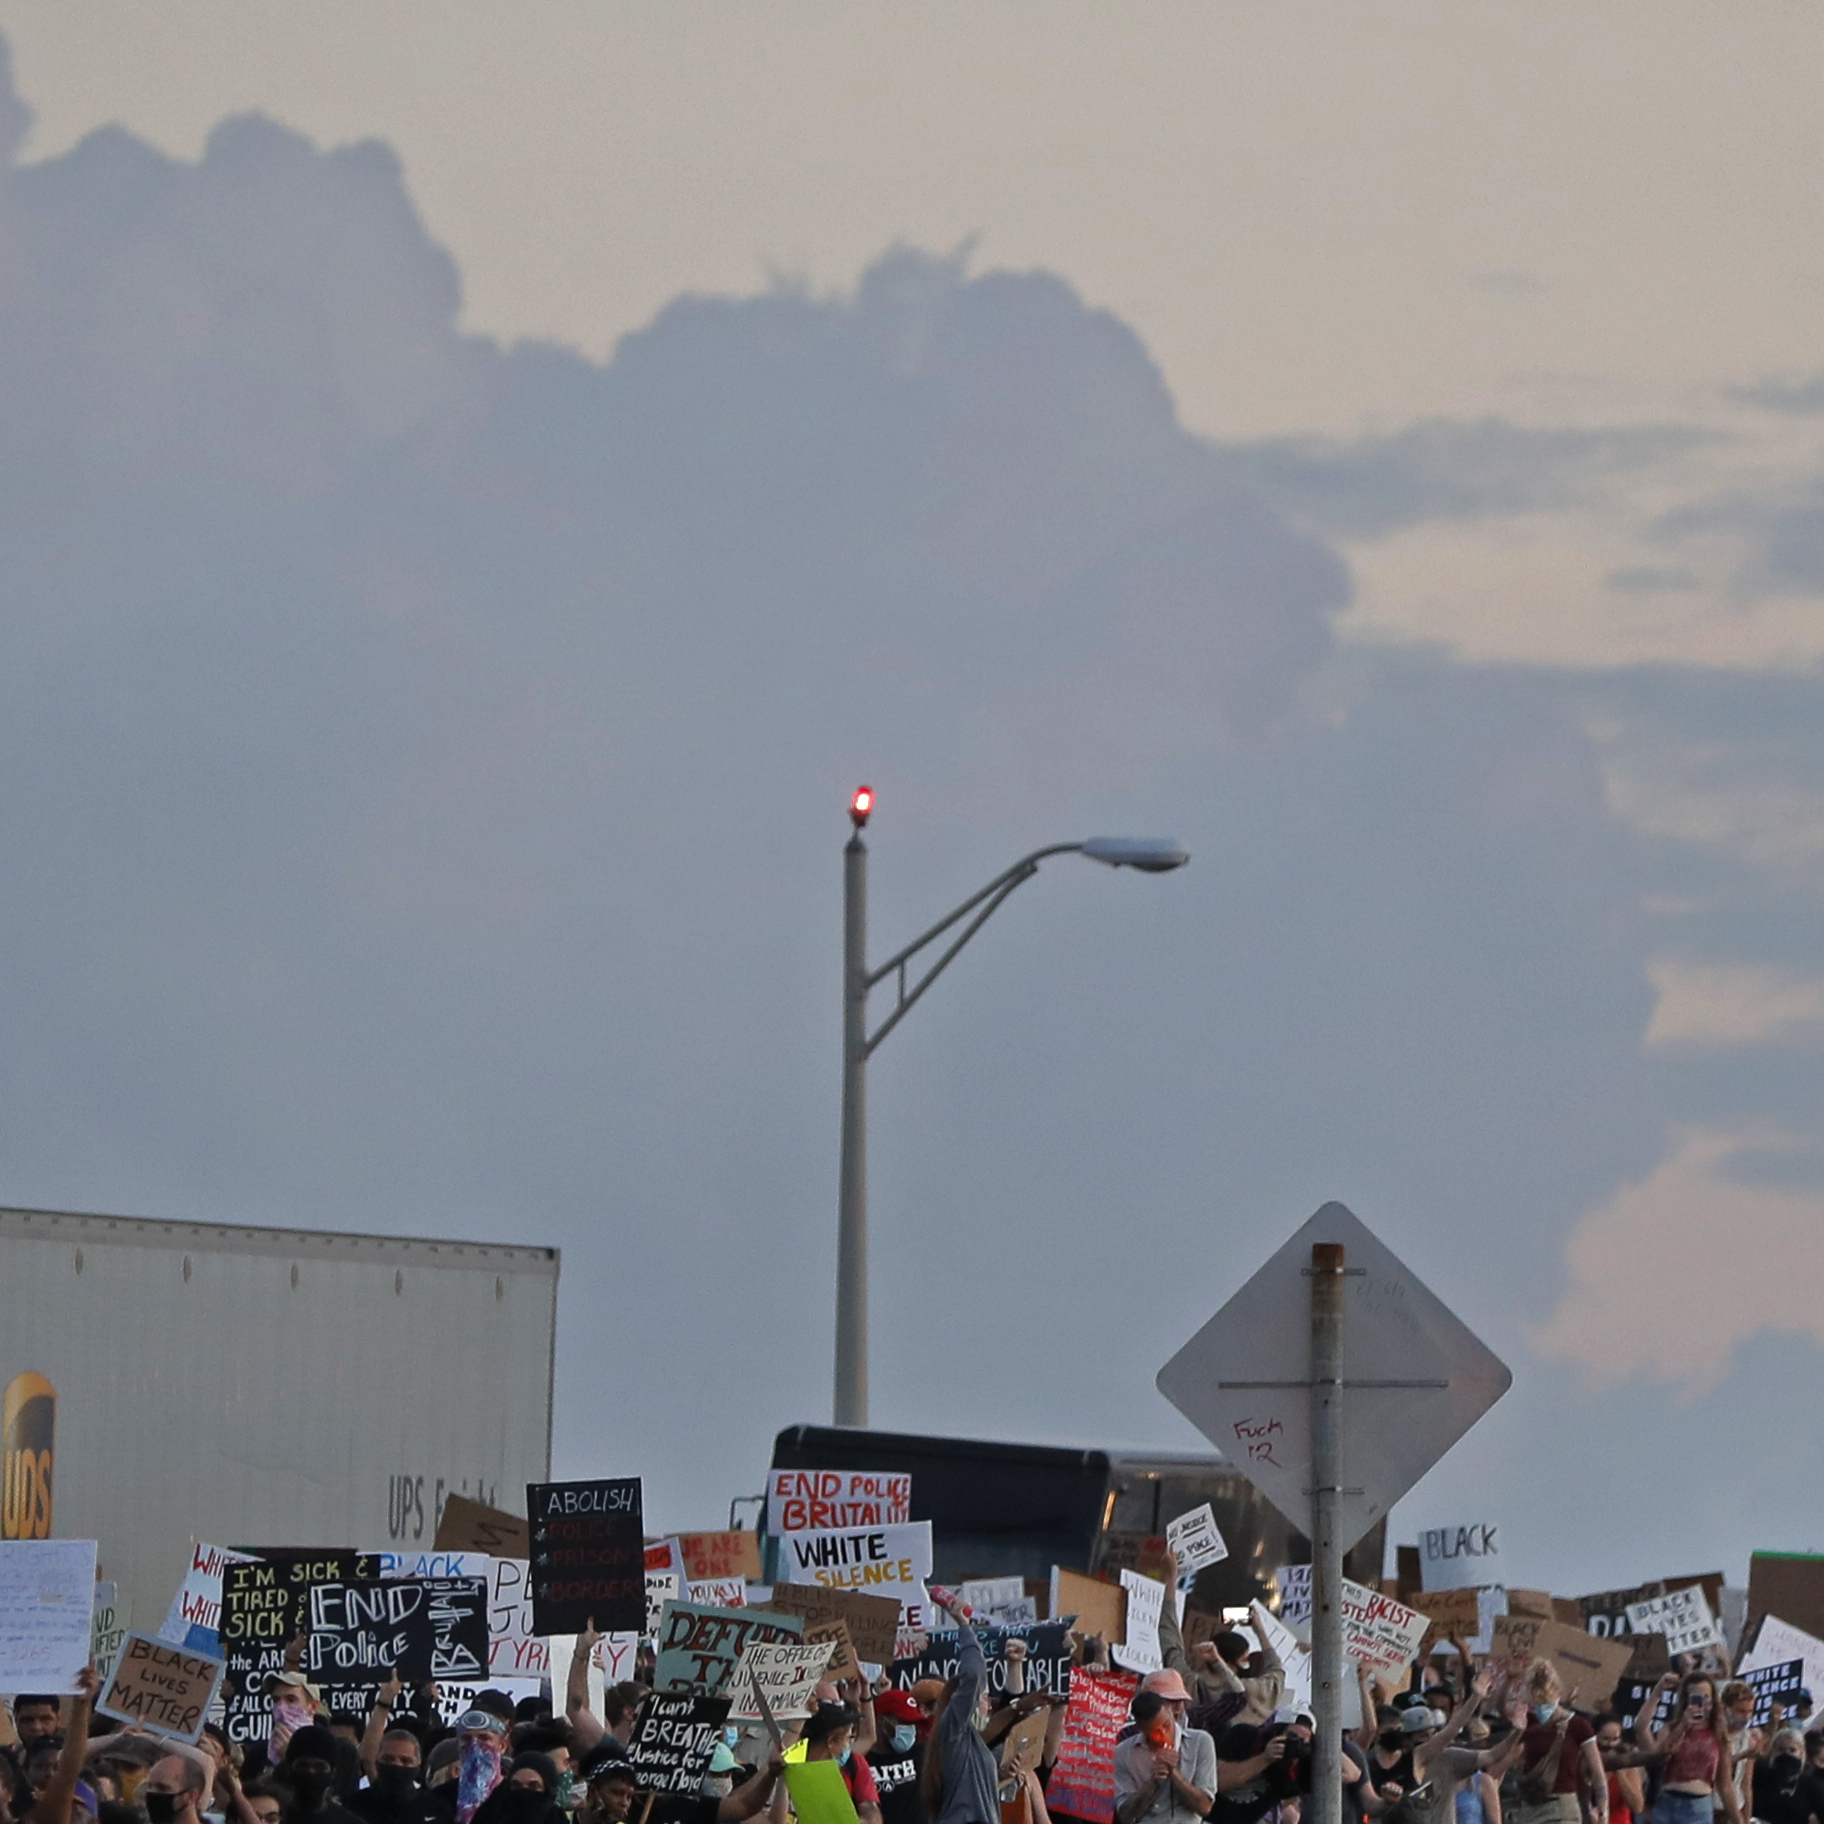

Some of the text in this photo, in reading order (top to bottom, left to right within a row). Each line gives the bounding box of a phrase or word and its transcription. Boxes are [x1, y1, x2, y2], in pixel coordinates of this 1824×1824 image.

[547, 1488, 635, 1514] ABOLISH
[776, 1473, 910, 1502] END POLICE
[388, 1475, 424, 1541] UPS
[548, 1520, 616, 1541] POLICE
[1426, 1525, 1498, 1561] BLACK
[793, 1533, 888, 1569] WHITE
[233, 1564, 276, 1588] I'M
[290, 1561, 341, 1582] SICK
[694, 1558, 732, 1576] ONE
[814, 1557, 914, 1587] SILENCE
[227, 1587, 289, 1611] TIRED
[309, 1582, 423, 1631] END
[1365, 1594, 1416, 1629] RACIST
[1636, 1591, 1693, 1621] BLACK
[225, 1611, 285, 1638] SICK
[130, 1639, 215, 1682] BLACK
[230, 1653, 252, 1671] the
[747, 1642, 771, 1666] THE
[140, 1668, 189, 1695] LIVES
[1744, 1663, 1792, 1686] WHITE
[105, 1679, 202, 1733] MATTER
[242, 1696, 262, 1713] ALL
[331, 1690, 369, 1711] EVERY
[641, 1719, 724, 1757] BREATHE
[626, 1744, 705, 1770] #Justice for
[668, 1767, 706, 1793] Floyd
